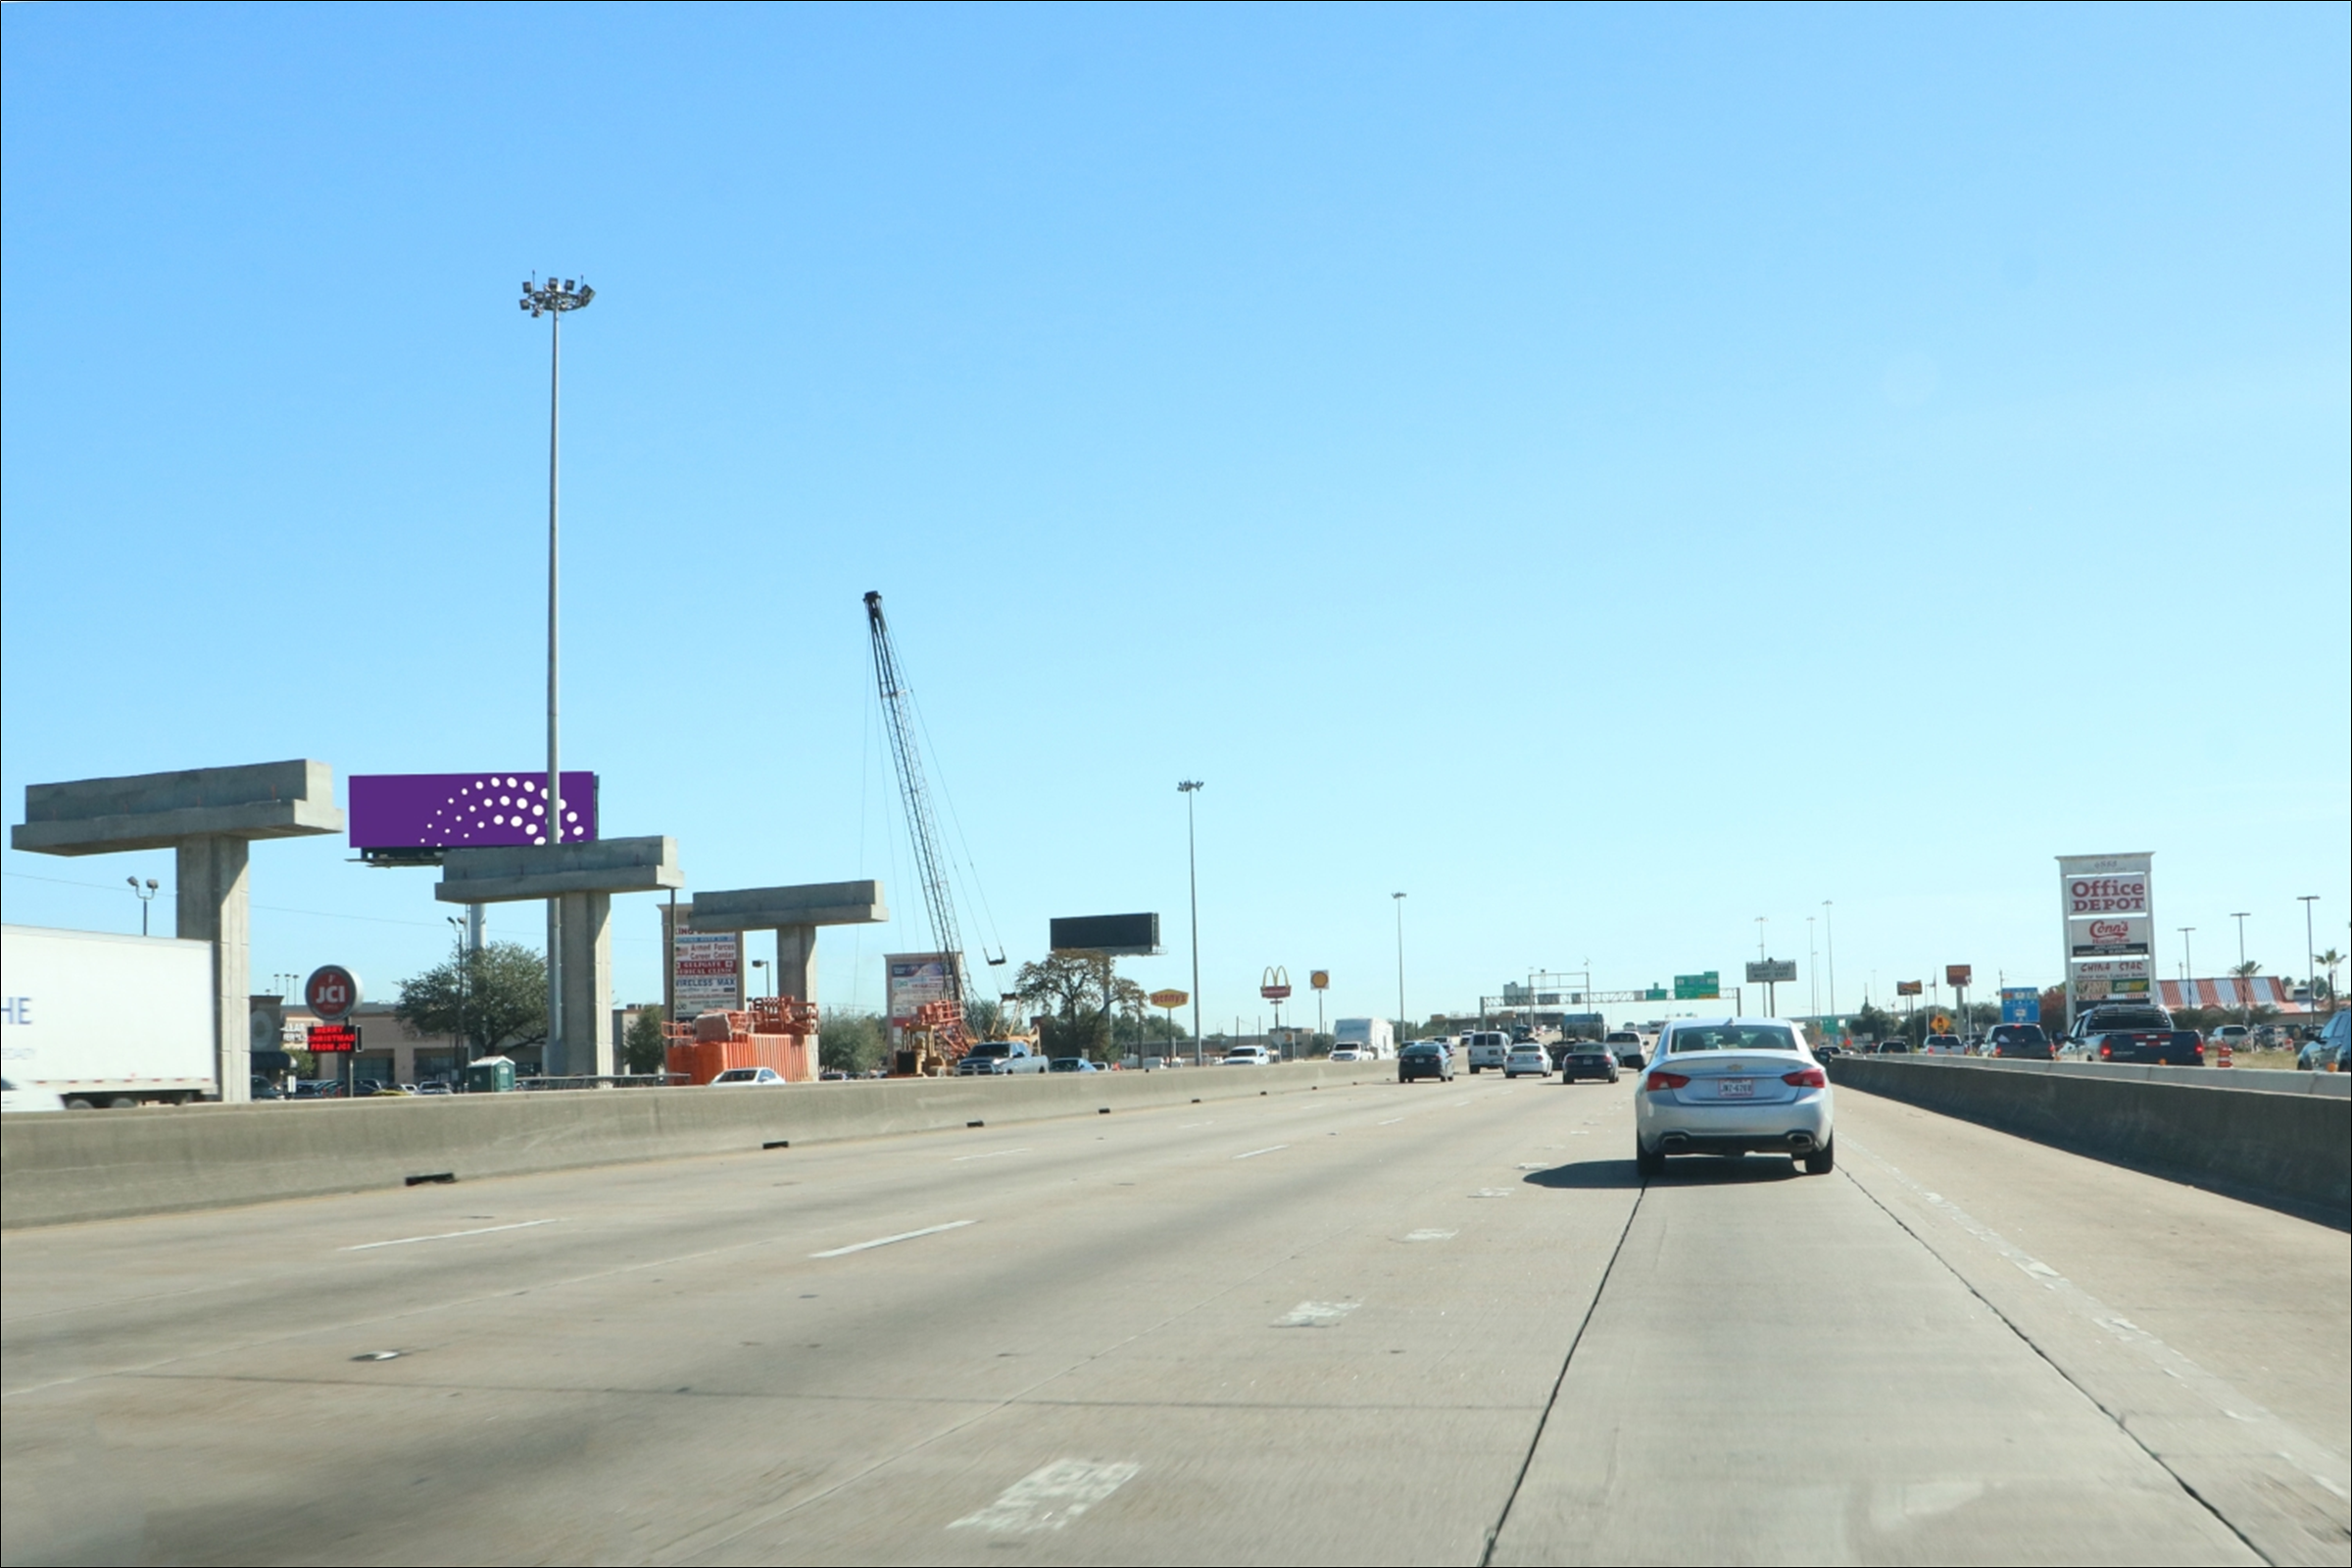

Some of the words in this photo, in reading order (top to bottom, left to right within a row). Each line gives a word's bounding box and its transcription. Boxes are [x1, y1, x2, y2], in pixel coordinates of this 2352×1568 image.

[2072, 879, 2144, 898] Office
[2073, 898, 2144, 911] DEPOT
[2089, 920, 2129, 938] Conn's
[2081, 962, 2111, 972] CHINA
[2119, 961, 2143, 971] STAR
[316, 986, 346, 1004] JCI
[1152, 994, 1187, 1004] Denny's
[315, 1025, 344, 1034] MERRY
